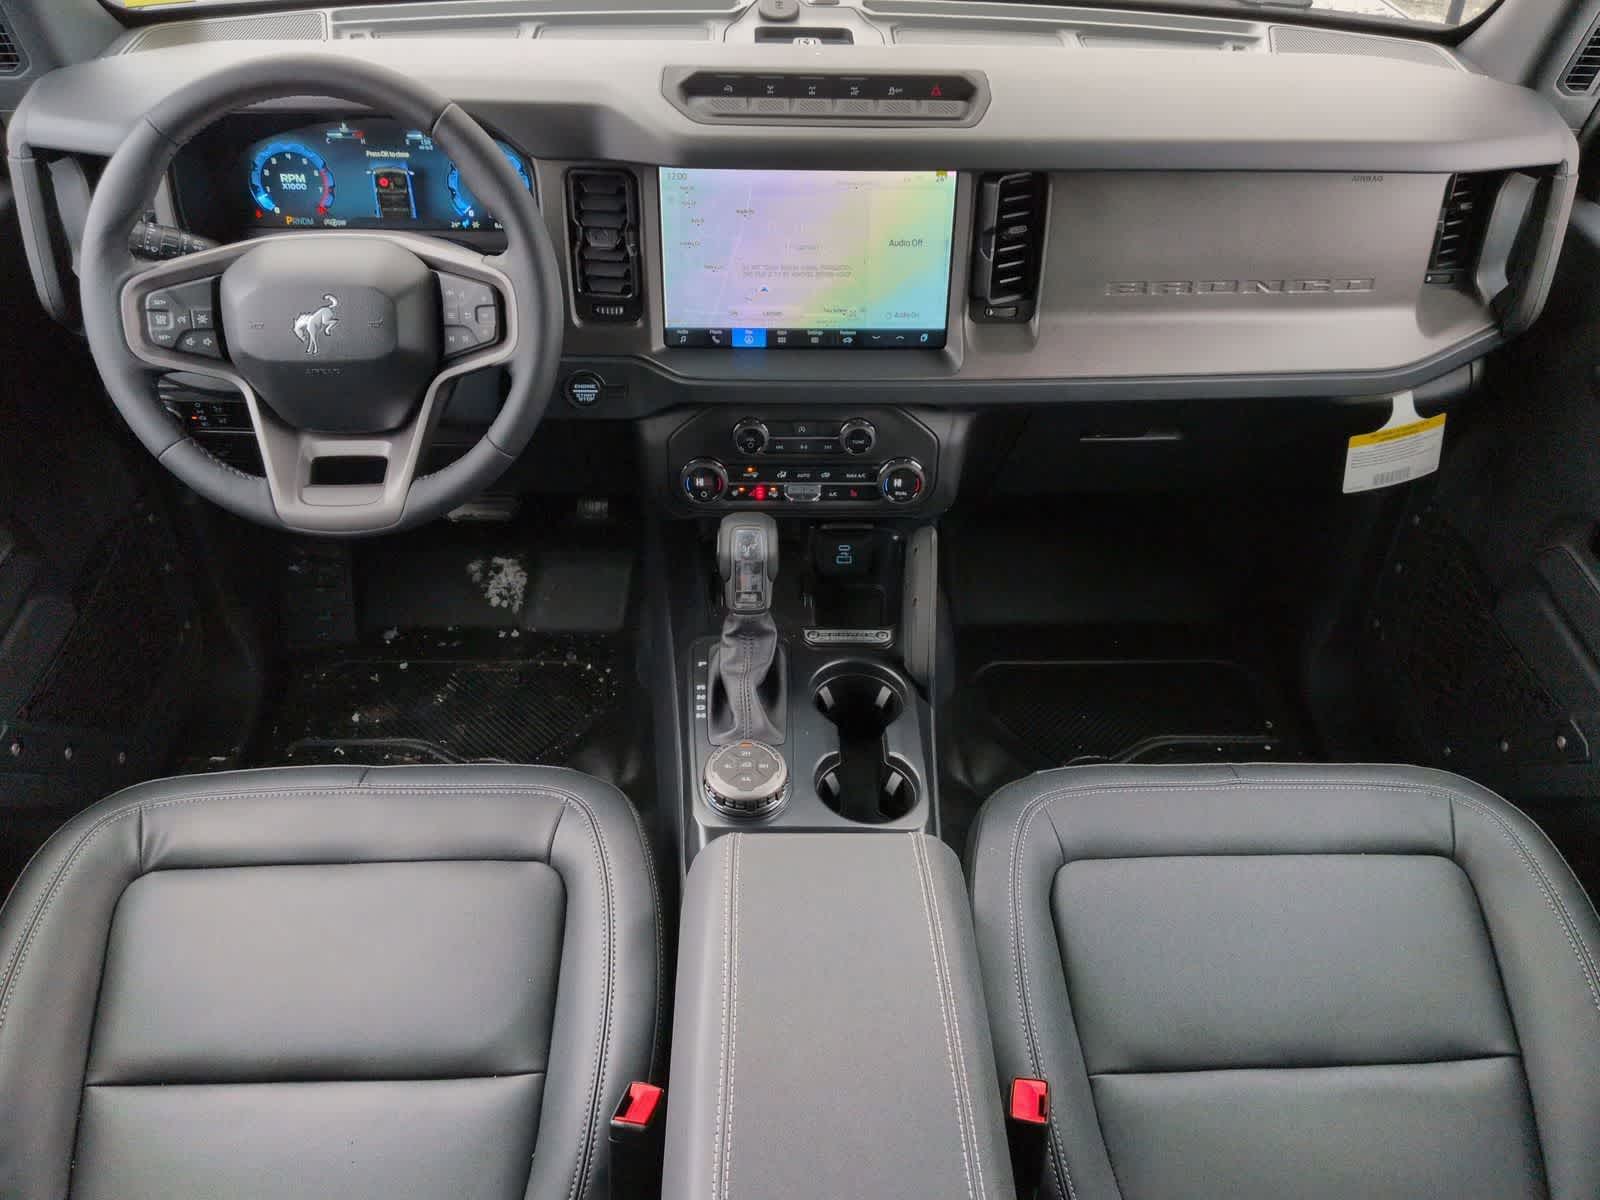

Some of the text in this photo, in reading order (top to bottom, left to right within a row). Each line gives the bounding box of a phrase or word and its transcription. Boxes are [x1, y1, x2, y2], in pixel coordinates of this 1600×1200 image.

[280, 173, 306, 183] RPM
[282, 183, 308, 191] X1000
[888, 238, 924, 248] Audio Off
[1105, 278, 1377, 296] BRONCO
